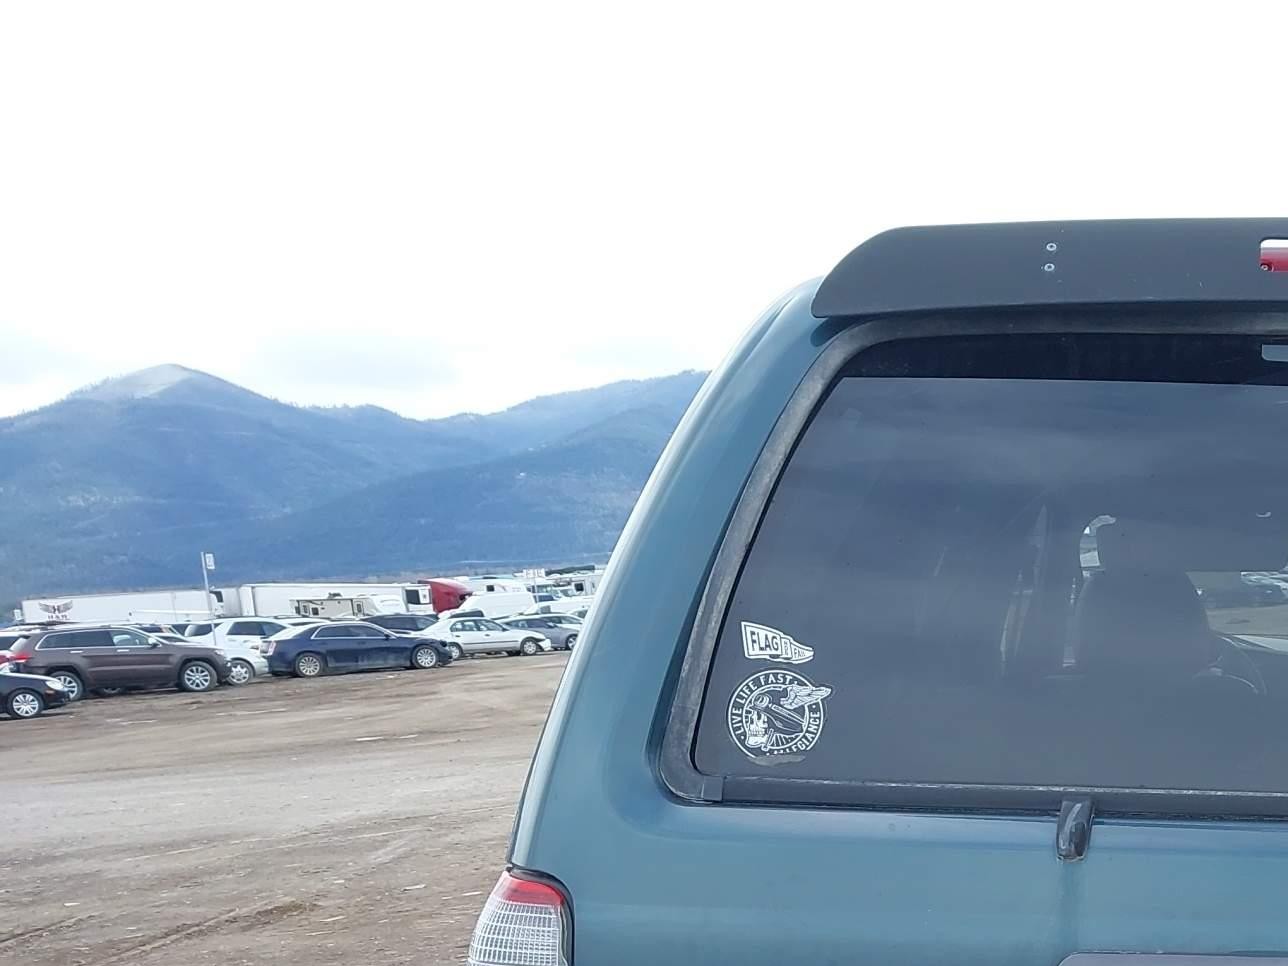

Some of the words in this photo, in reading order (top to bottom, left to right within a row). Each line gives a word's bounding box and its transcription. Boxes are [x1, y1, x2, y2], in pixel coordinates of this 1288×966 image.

[749, 629, 779, 652] FLAG
[759, 673, 793, 686] FAST
[735, 680, 758, 705] LIFE
[732, 707, 745, 735] LIVE
